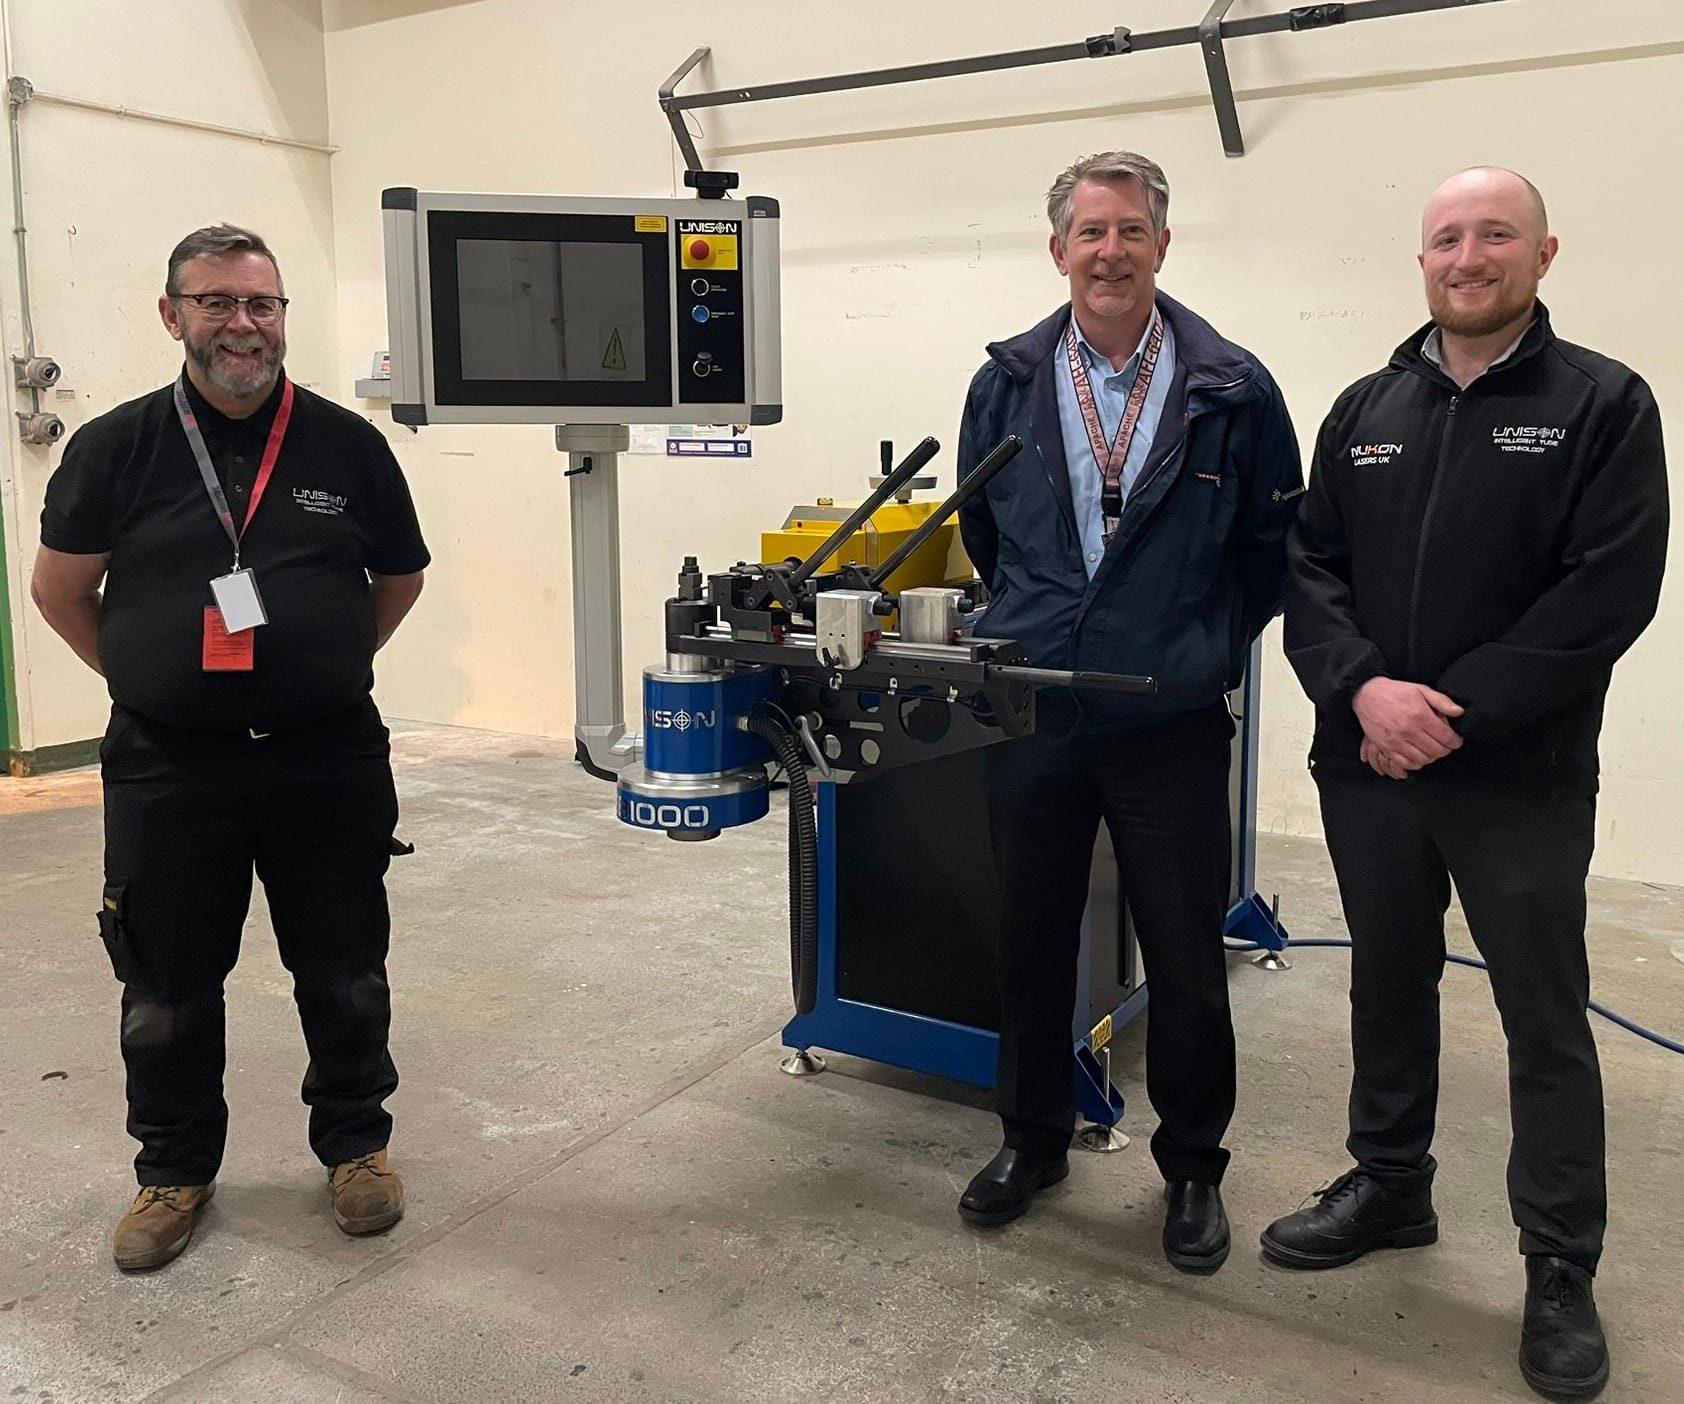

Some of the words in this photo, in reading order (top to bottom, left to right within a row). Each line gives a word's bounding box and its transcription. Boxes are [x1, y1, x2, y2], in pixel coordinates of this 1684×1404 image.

[680, 222, 737, 233] UNISON
[1117, 410, 1134, 448] APACHE
[1492, 427, 1566, 440] UNISON
[1351, 444, 1403, 458] NUKON
[1378, 455, 1391, 464] UK
